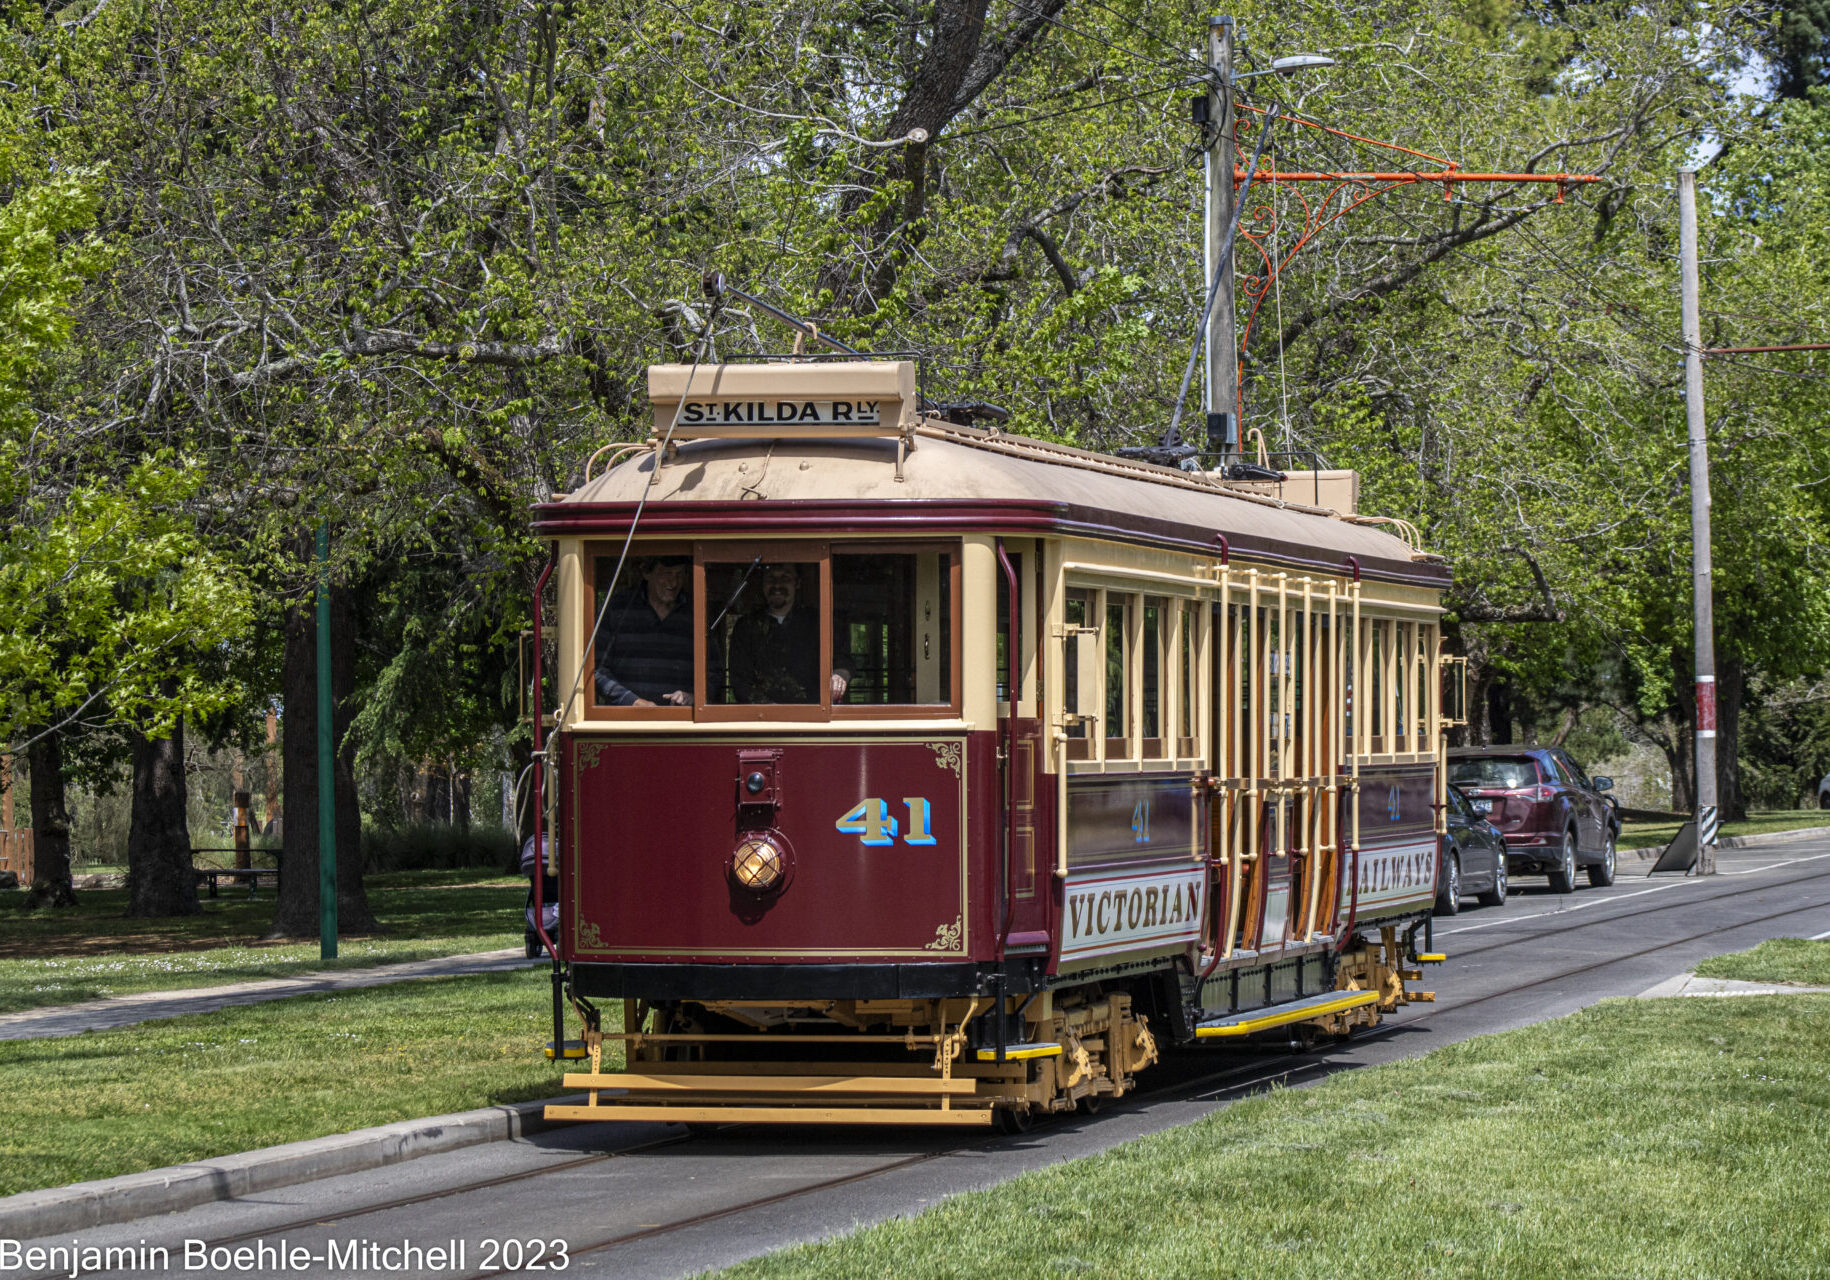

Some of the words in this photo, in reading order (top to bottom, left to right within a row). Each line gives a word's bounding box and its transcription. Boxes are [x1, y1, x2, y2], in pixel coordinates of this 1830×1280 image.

[723, 402, 820, 421] KILDA
[835, 797, 937, 846] 41
[1069, 881, 1201, 938] VICTORIAN
